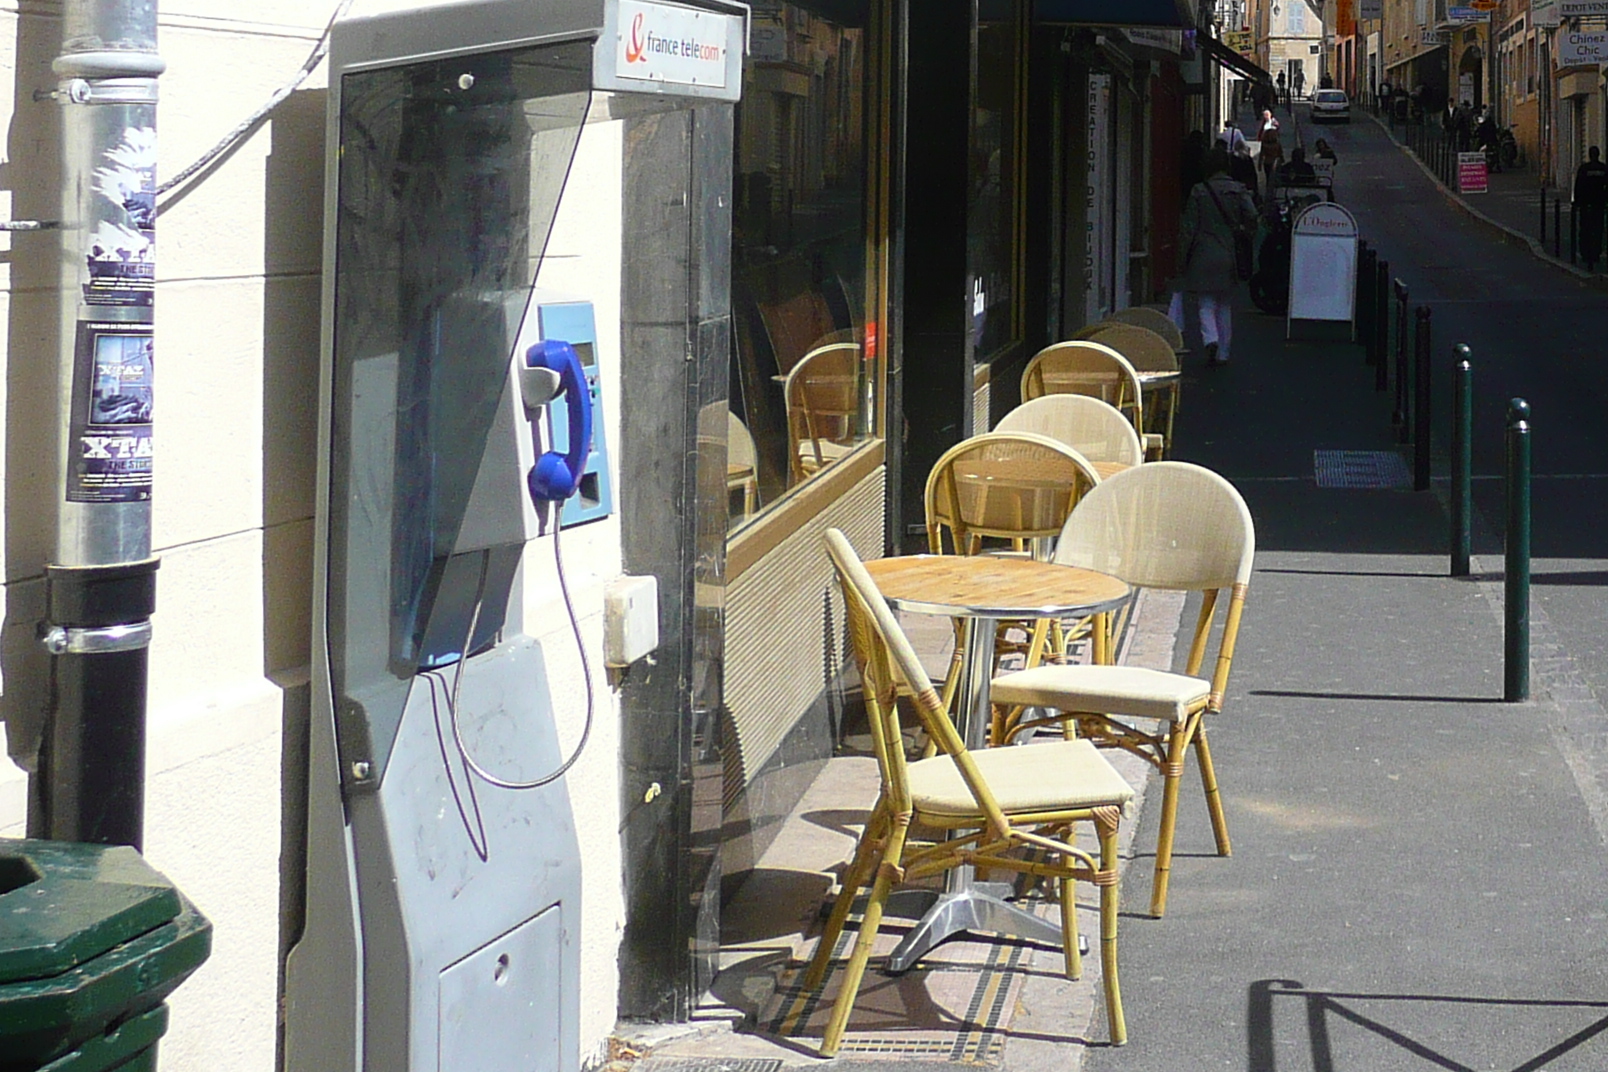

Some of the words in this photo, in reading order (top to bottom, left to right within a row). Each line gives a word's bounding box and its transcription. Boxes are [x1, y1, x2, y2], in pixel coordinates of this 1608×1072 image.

[647, 31, 679, 55] france
[681, 38, 719, 61] telecom
[1577, 46, 1600, 56] Chic
[1087, 186, 1095, 208] DE
[81, 437, 153, 459] XTA
